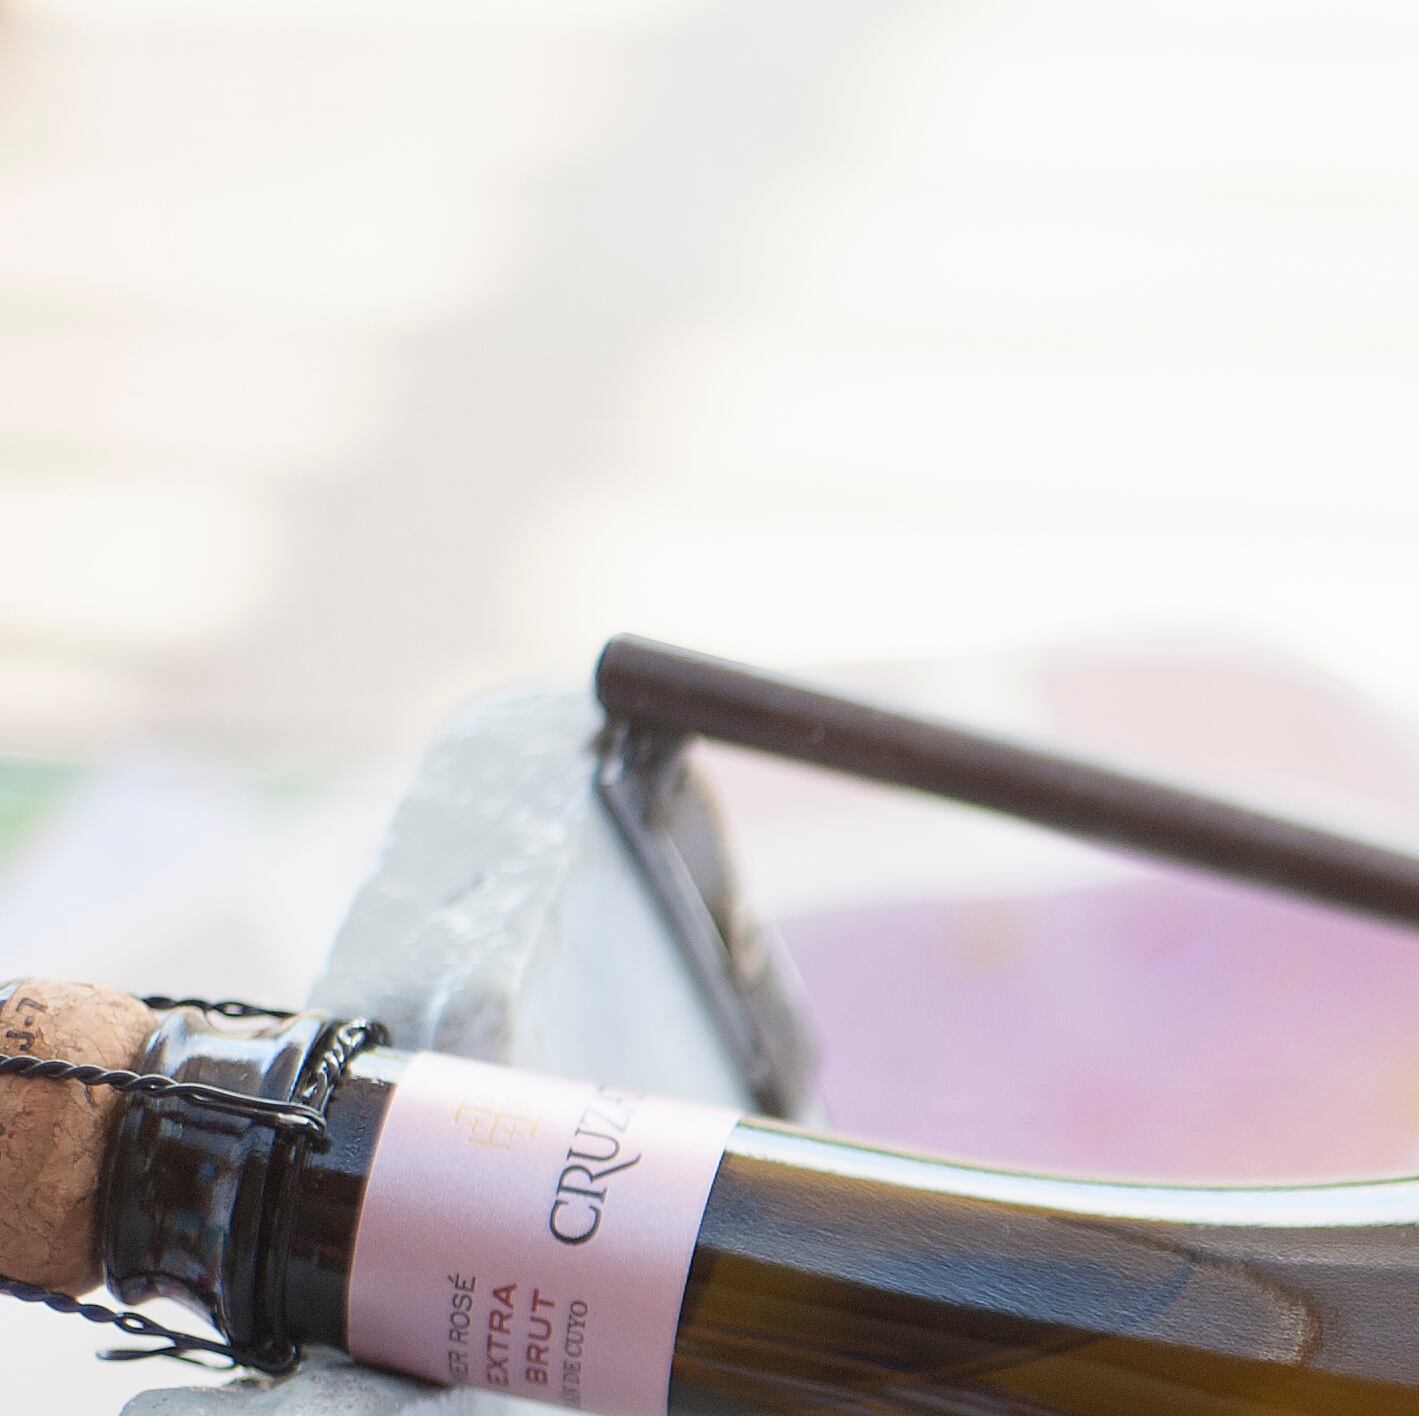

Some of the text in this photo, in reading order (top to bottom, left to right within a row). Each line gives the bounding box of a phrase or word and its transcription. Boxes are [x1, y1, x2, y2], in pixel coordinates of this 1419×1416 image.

[447, 1273, 476, 1345] ROSÉ
[487, 1282, 517, 1387] EXTRA
[525, 1287, 555, 1386] BRUT
[564, 1299, 588, 1359] CUYO
[562, 1360, 581, 1385] DE
